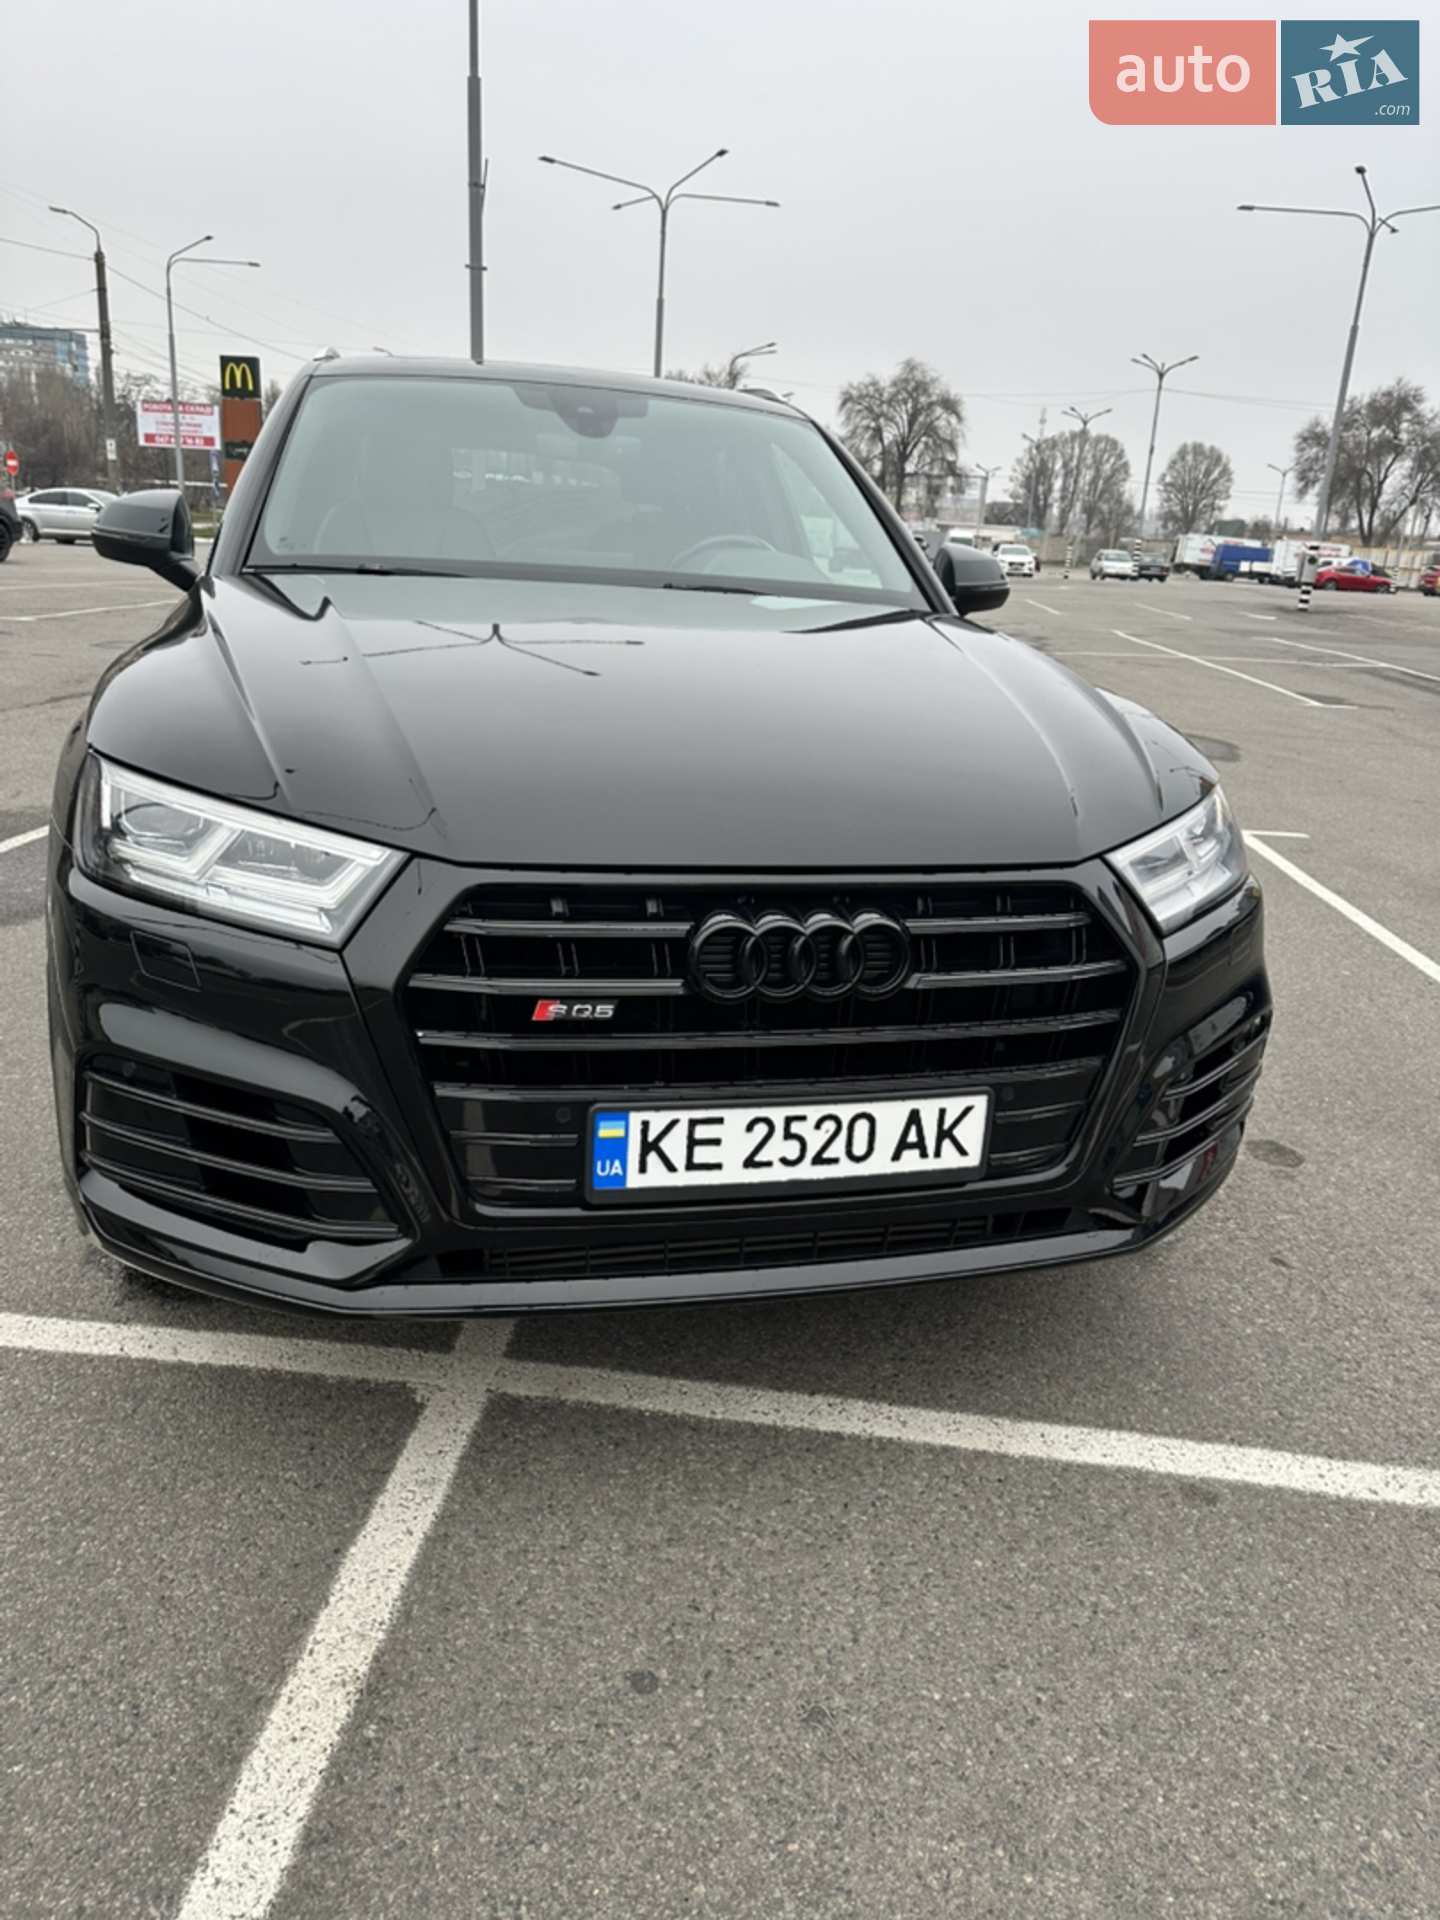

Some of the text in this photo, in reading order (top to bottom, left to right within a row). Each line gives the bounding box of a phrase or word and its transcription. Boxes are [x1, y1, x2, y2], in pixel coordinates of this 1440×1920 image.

[548, 1003, 615, 1019] SQ5
[638, 1105, 975, 1174] KE 2520 AK
[596, 1158, 623, 1177] UA
